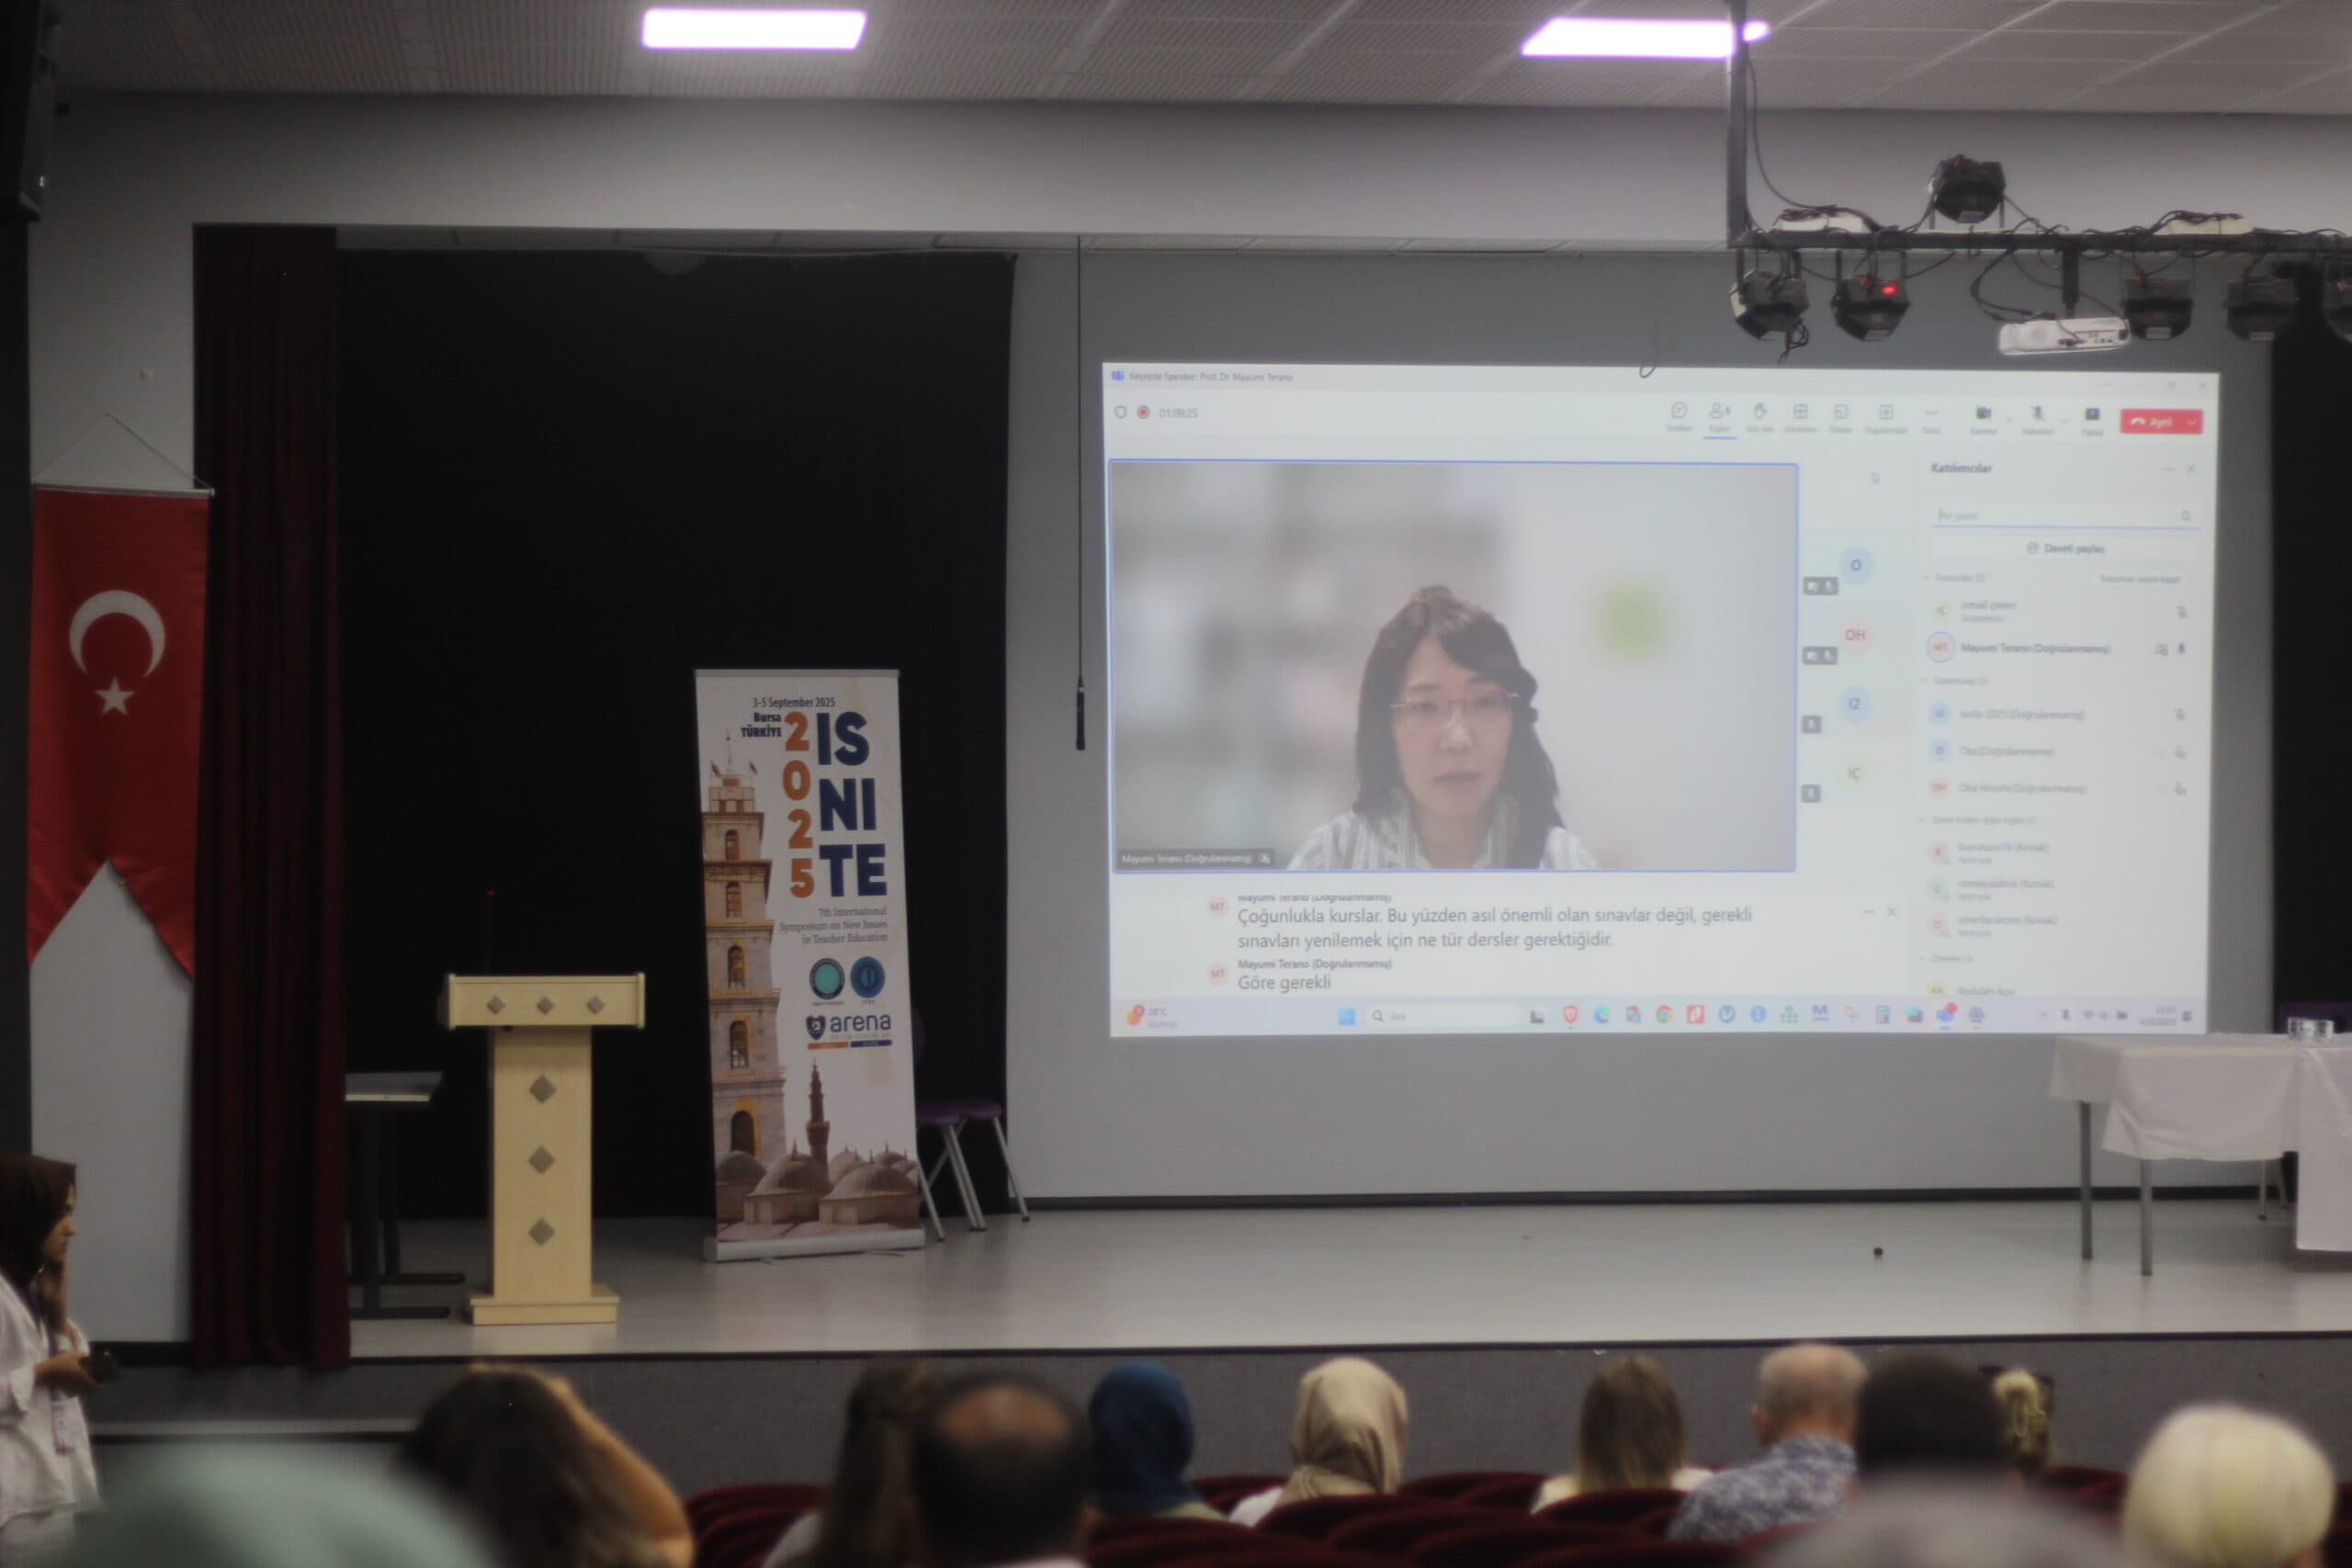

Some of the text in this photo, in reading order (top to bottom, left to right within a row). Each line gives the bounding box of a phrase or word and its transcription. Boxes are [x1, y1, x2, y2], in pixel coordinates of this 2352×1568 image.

[1129, 372, 1163, 383] Keynote
[1159, 408, 1198, 419] 01:09:25
[753, 697, 835, 709] 3-5 September 2025
[753, 712, 781, 722] Bursa
[741, 723, 783, 738] TÜRKİYE
[817, 711, 870, 766] IS
[819, 778, 876, 831] NI
[819, 843, 888, 897] TE
[833, 906, 888, 918] International
[1238, 906, 1753, 927] Çoğunlukla kurslar. Bu yüzden asıl önemli olan sınavlar değil, gerekli
[779, 921, 828, 933] Symposium
[842, 920, 861, 930] New
[863, 919, 888, 930] Issues
[813, 933, 846, 943] Teacher
[847, 933, 888, 943] Education
[1238, 931, 1613, 952] sınavları yenilemek için ne tür dersler gerektiğidir.
[1238, 959, 1275, 970] Mayumi
[1279, 959, 1309, 969] Terano
[1238, 974, 1331, 994] Göre gerekli
[831, 1014, 891, 1032] arena
